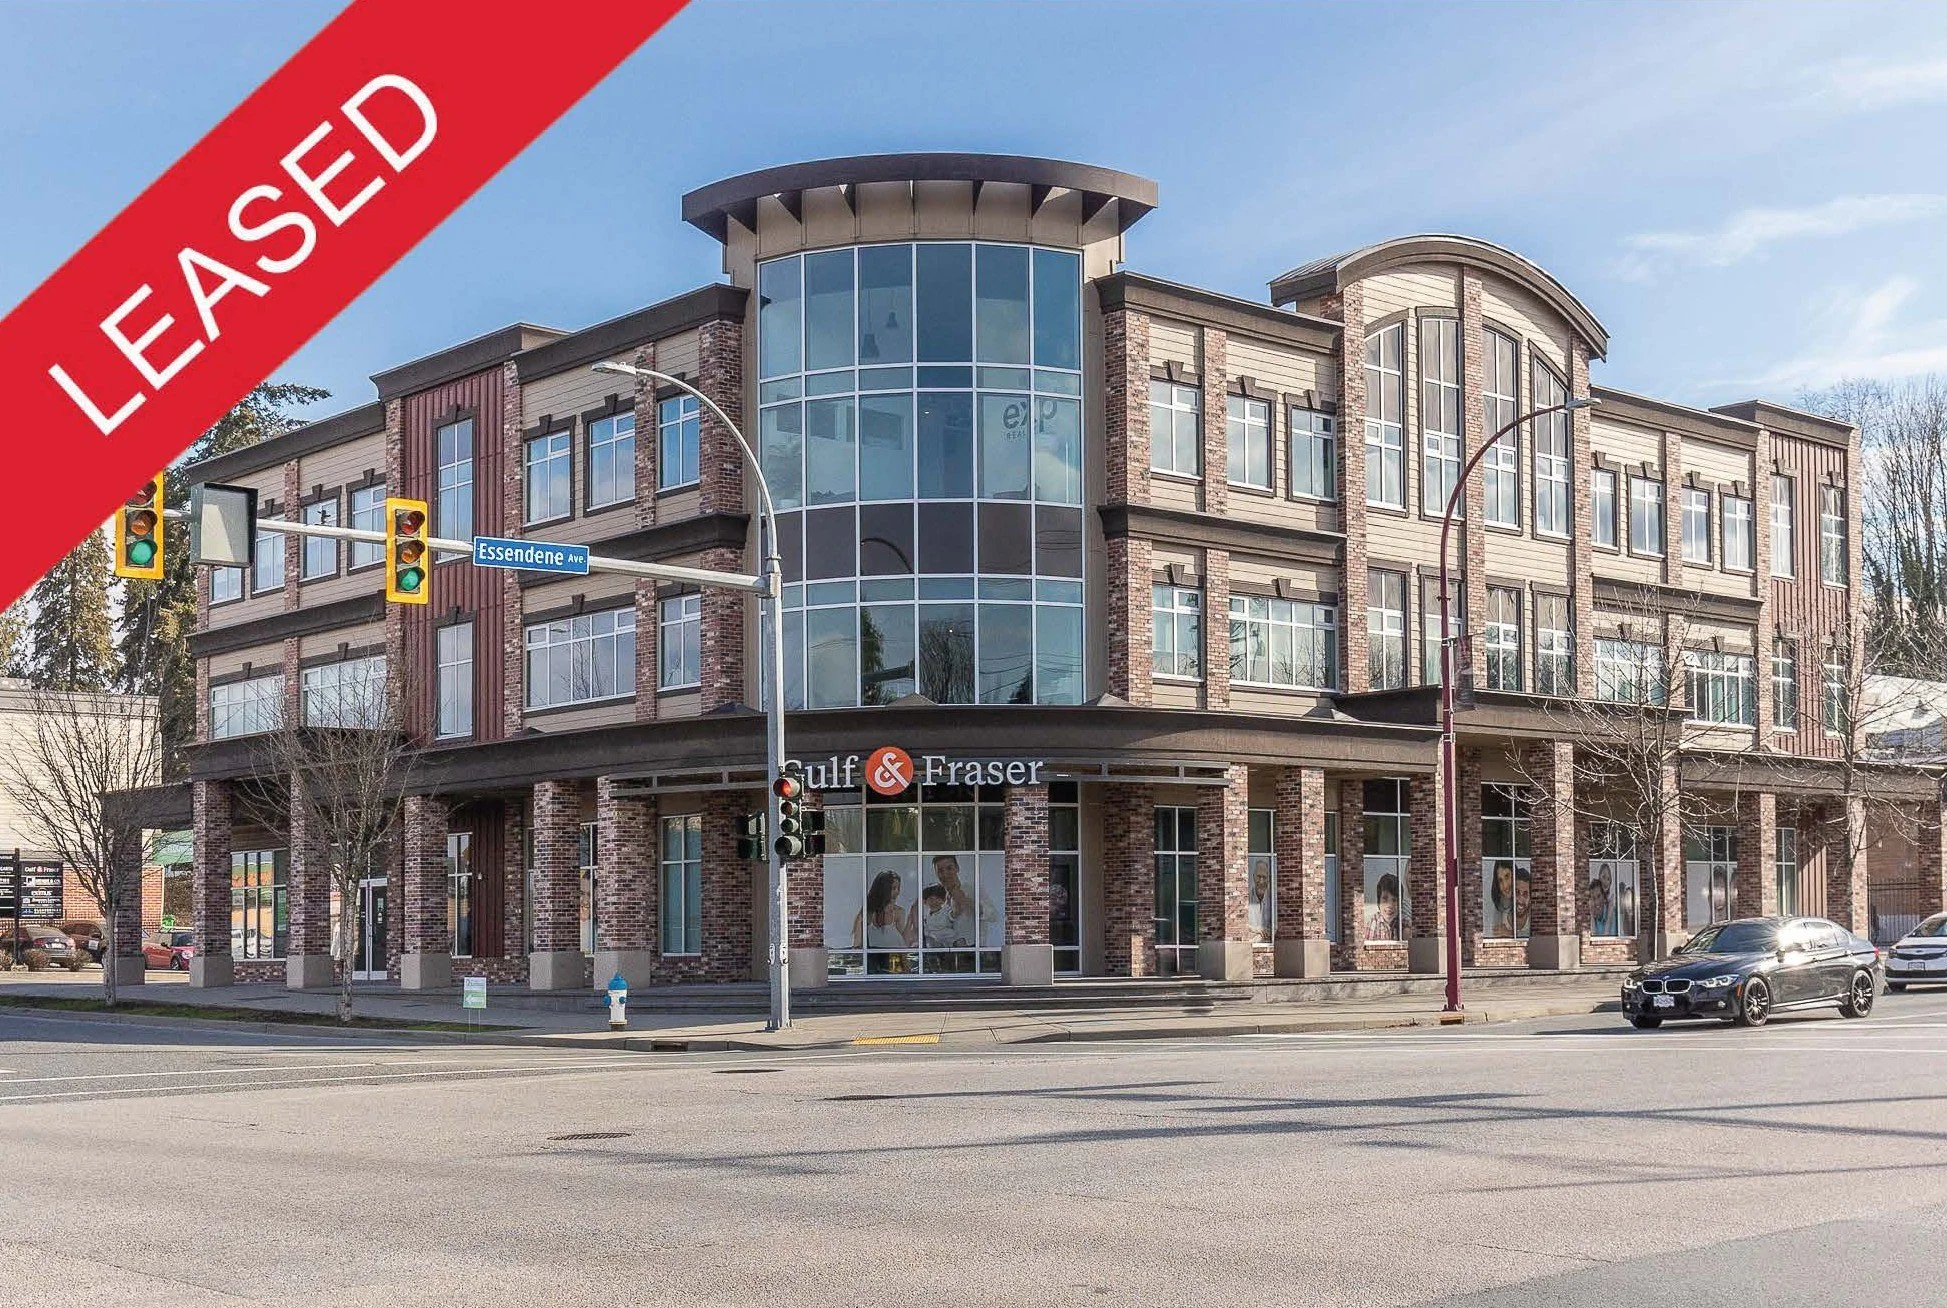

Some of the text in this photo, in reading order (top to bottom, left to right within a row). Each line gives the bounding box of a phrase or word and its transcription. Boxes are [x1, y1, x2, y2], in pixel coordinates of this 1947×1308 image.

[479, 543, 564, 566] Essendene
[872, 751, 911, 790] &
[921, 754, 1044, 787] Fraser
